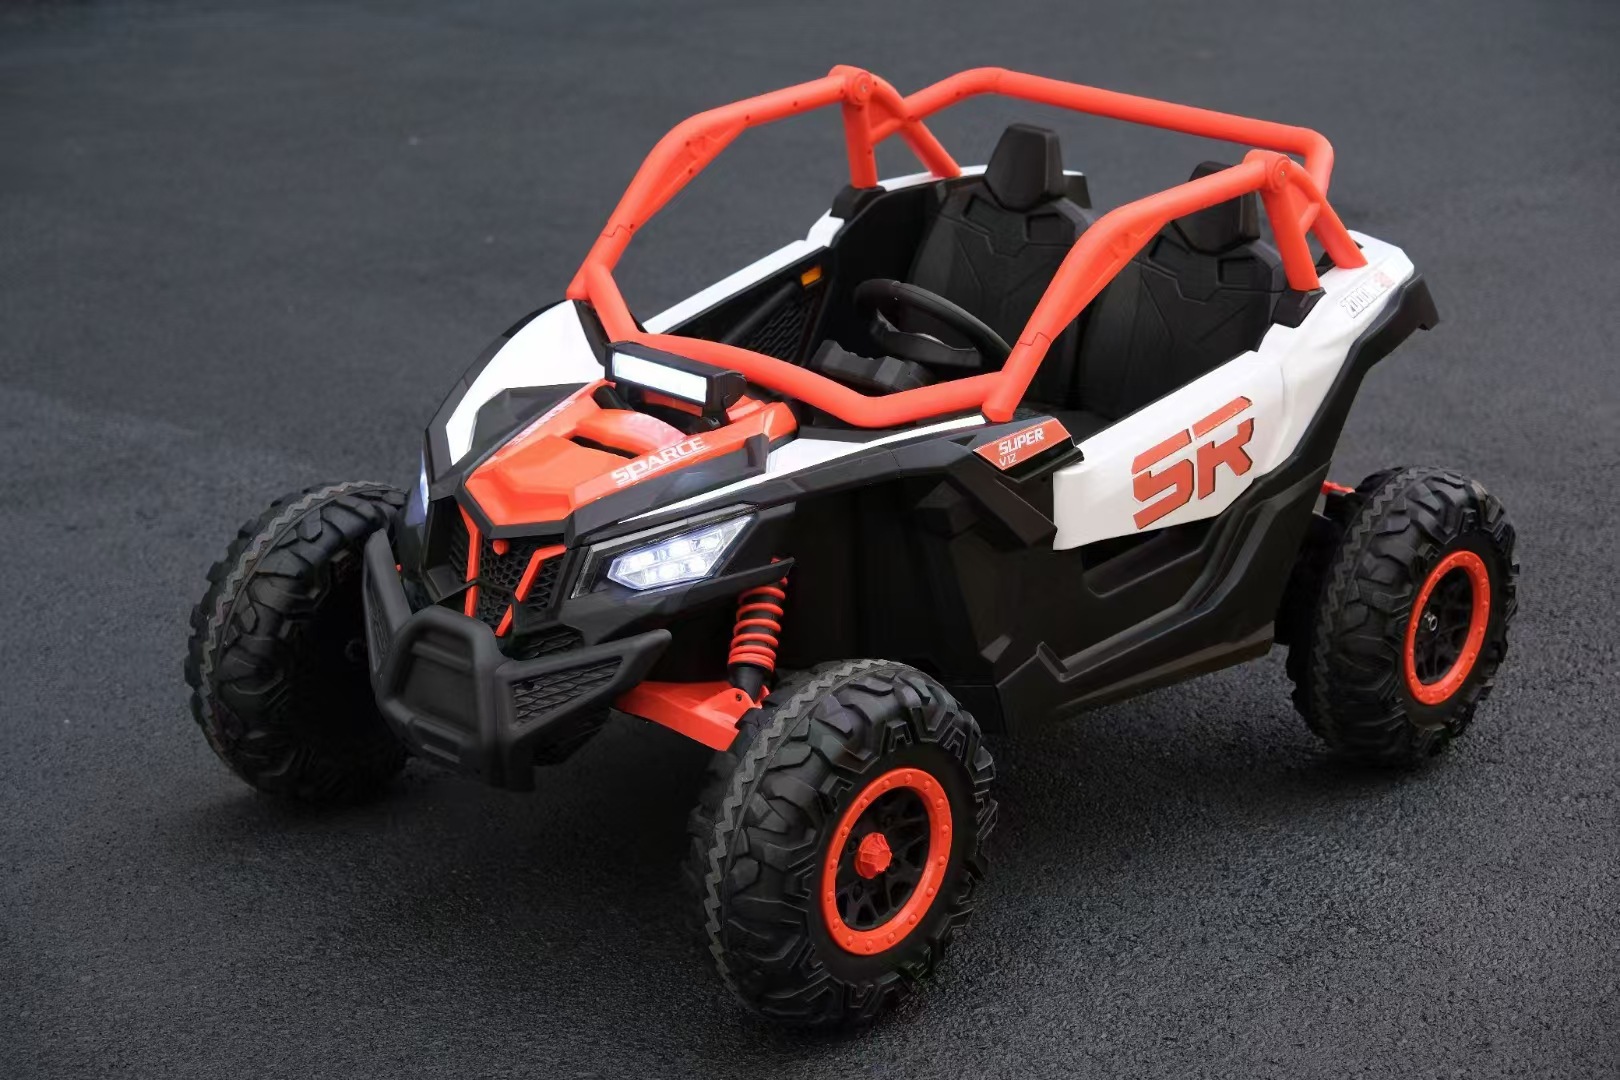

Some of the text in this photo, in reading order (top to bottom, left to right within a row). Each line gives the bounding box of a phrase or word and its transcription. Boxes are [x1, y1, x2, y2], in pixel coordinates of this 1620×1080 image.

[998, 427, 1044, 455] SUPER
[999, 454, 1017, 467] V12
[1132, 395, 1254, 530] SR
